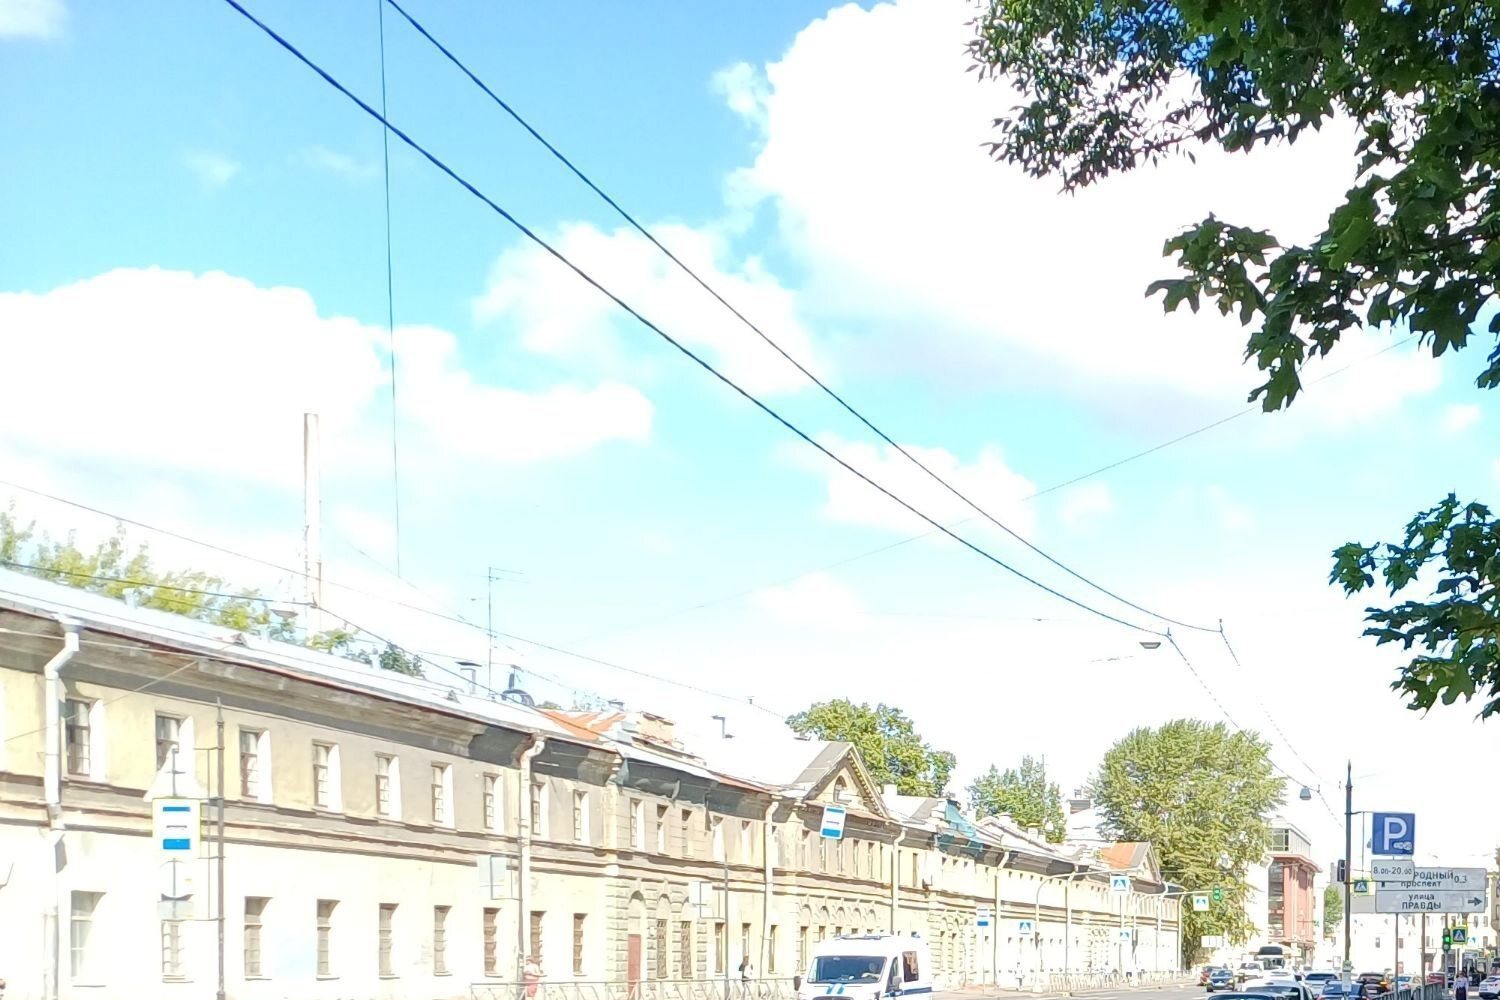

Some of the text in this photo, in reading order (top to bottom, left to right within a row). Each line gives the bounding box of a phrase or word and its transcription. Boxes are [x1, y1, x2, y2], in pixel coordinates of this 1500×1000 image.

[1383, 816, 1407, 851] P
[1409, 893, 1435, 902] улица
[1402, 902, 1442, 911] ПРАВДЫ
